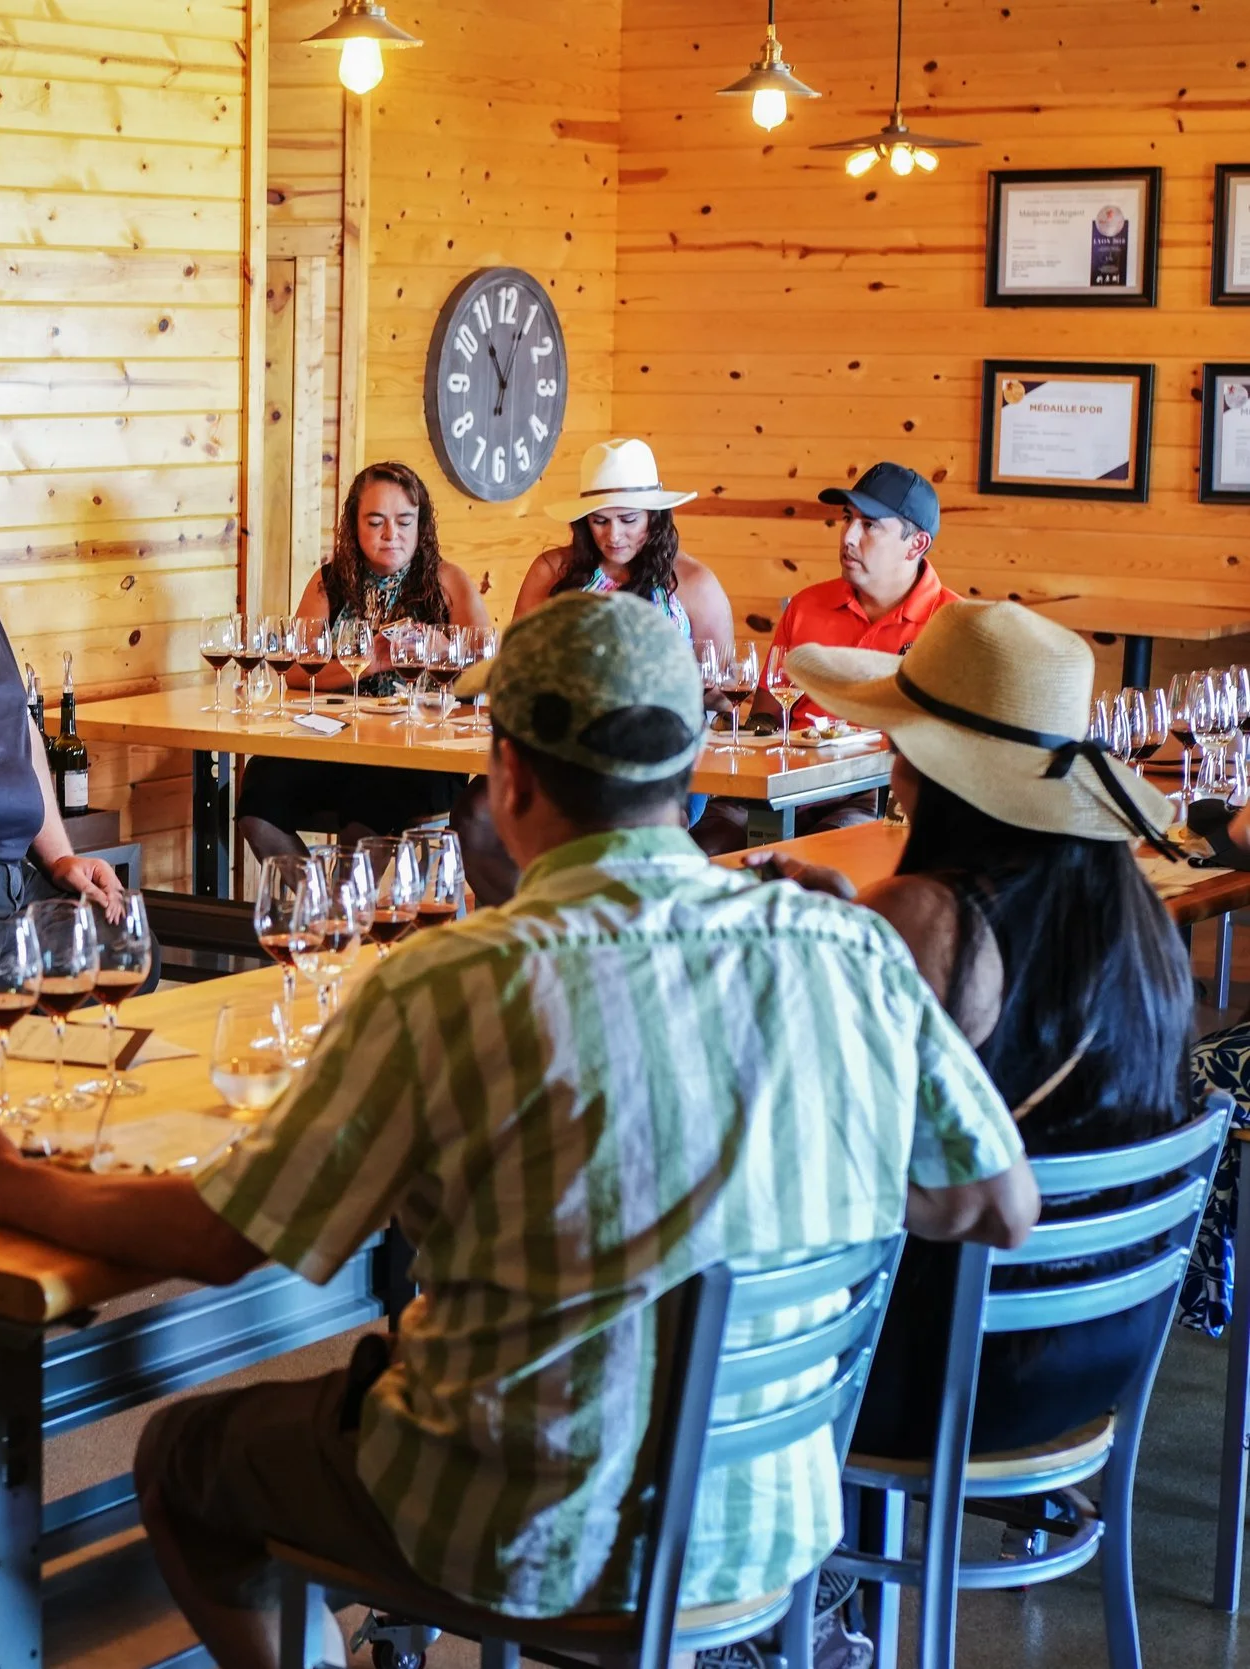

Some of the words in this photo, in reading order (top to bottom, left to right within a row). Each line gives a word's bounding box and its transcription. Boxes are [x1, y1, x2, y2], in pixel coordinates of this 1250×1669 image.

[472, 294, 493, 335] 11
[497, 286, 518, 325] 12
[522, 304, 539, 336] 1
[454, 323, 479, 363] 10
[530, 336, 554, 365] 2
[447, 372, 471, 394] 9
[536, 378, 557, 398] 3
[1029, 403, 1077, 414] MÉDAILLE
[1079, 404, 1103, 415] D'OR
[451, 411, 474, 440] 8
[528, 413, 549, 443] 4
[470, 435, 487, 472] 7
[492, 446, 505, 483] 6
[513, 436, 531, 472] 5
